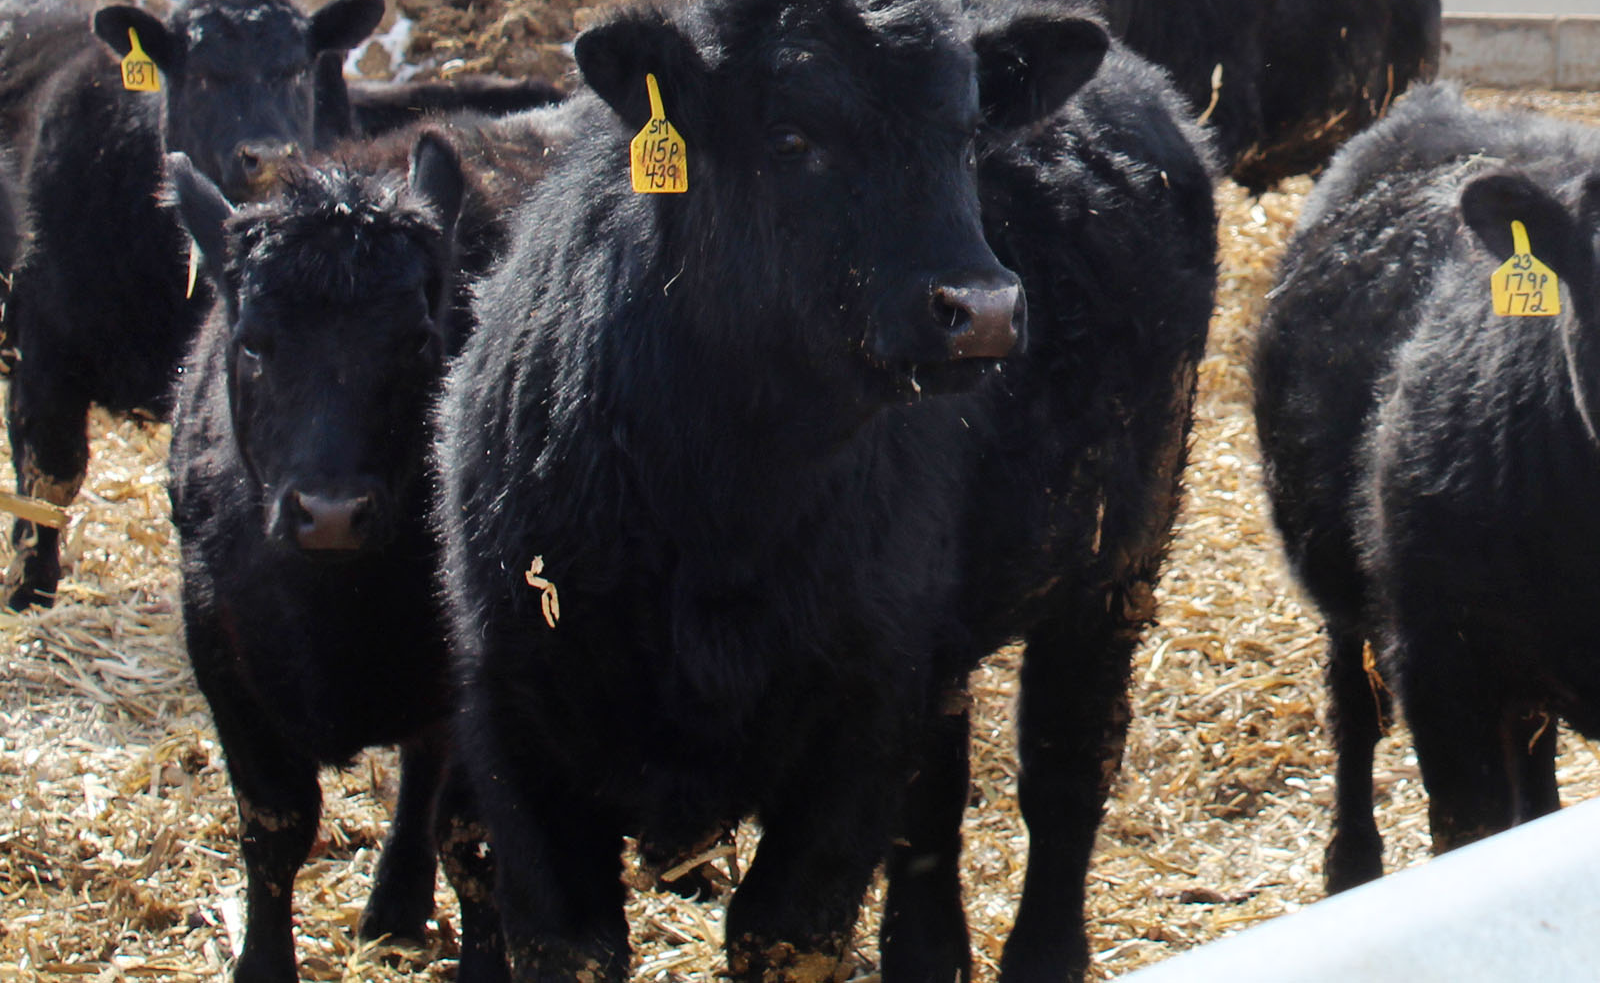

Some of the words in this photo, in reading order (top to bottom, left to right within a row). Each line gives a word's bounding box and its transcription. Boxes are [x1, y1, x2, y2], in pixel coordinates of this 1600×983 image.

[649, 119, 669, 135] SM
[642, 137, 679, 164] 115P
[645, 164, 677, 189] 439
[1512, 253, 1533, 270] 23
[1507, 291, 1548, 314] 172
